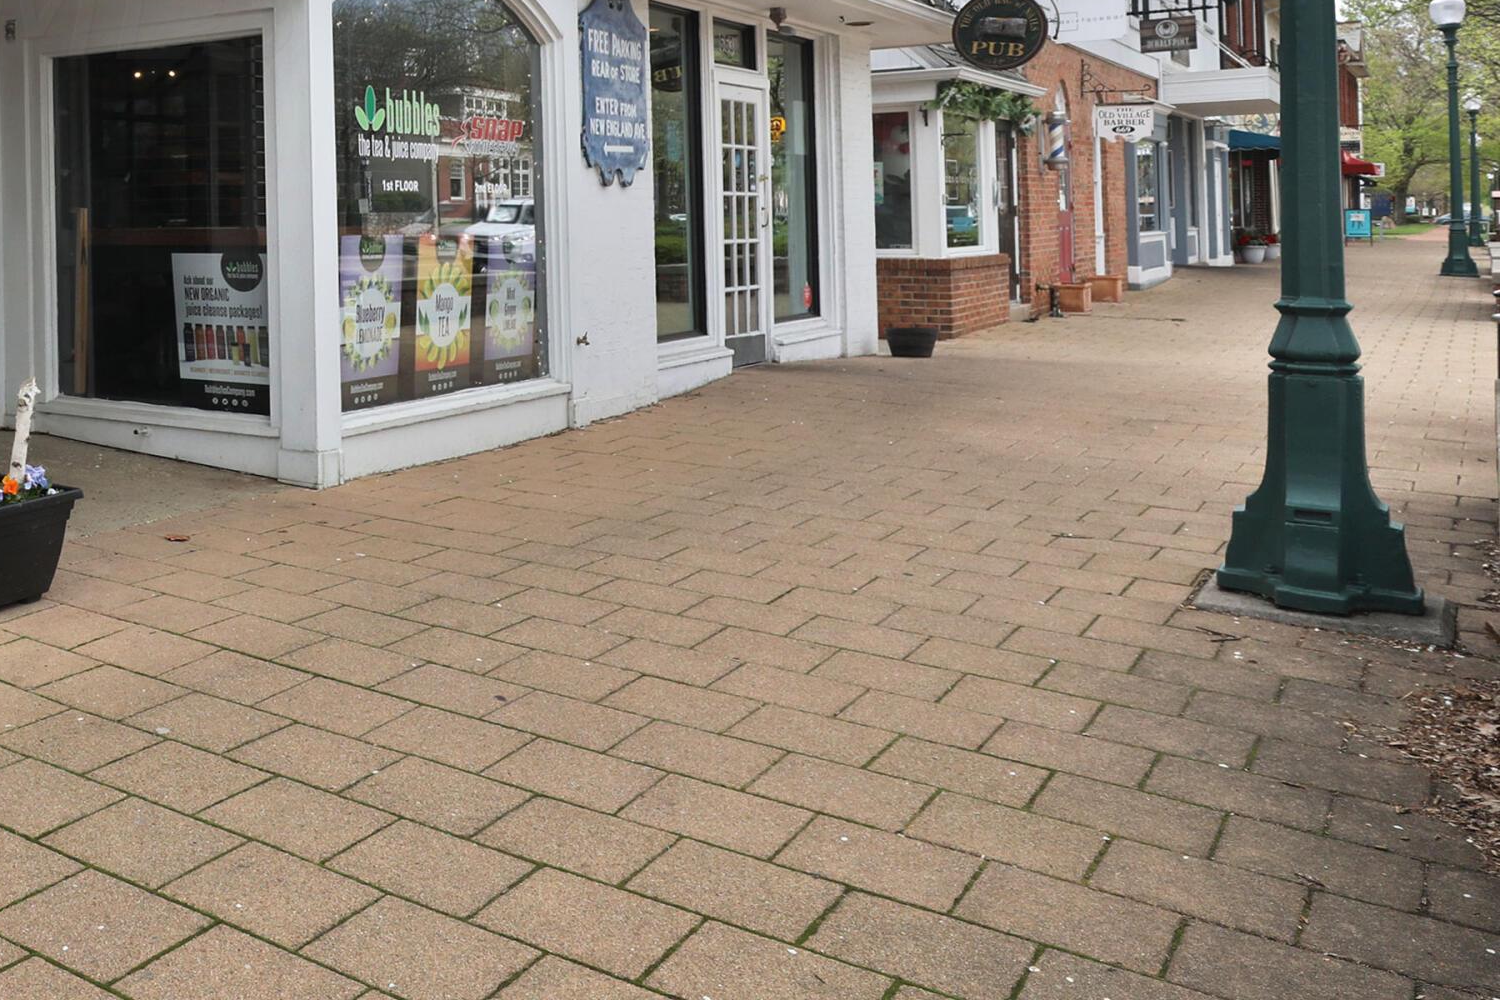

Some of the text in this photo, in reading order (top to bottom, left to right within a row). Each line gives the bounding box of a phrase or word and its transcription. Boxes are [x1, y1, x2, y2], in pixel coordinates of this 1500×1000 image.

[588, 29, 642, 61] FREE PARKING
[971, 41, 1025, 57] PUB
[591, 60, 610, 79] REAR
[619, 65, 641, 84] STORE
[385, 87, 440, 136] bubbles
[595, 96, 638, 118] ENTER FROM
[1099, 108, 1150, 119] OLD VILLAGE
[589, 117, 606, 136] NEW
[605, 119, 633, 138] ENGLAND
[358, 133, 371, 157] the
[371, 135, 383, 157] tea
[384, 135, 391, 158] &
[391, 136, 409, 161] juice
[409, 139, 439, 163] company
[382, 180, 419, 192] 1st FLOOR
[184, 287, 230, 301] NEW ORGANIC
[185, 302, 201, 317] juice
[202, 303, 228, 317] cleanse
[356, 303, 385, 325] Blueberry
[438, 316, 450, 337] TEA
